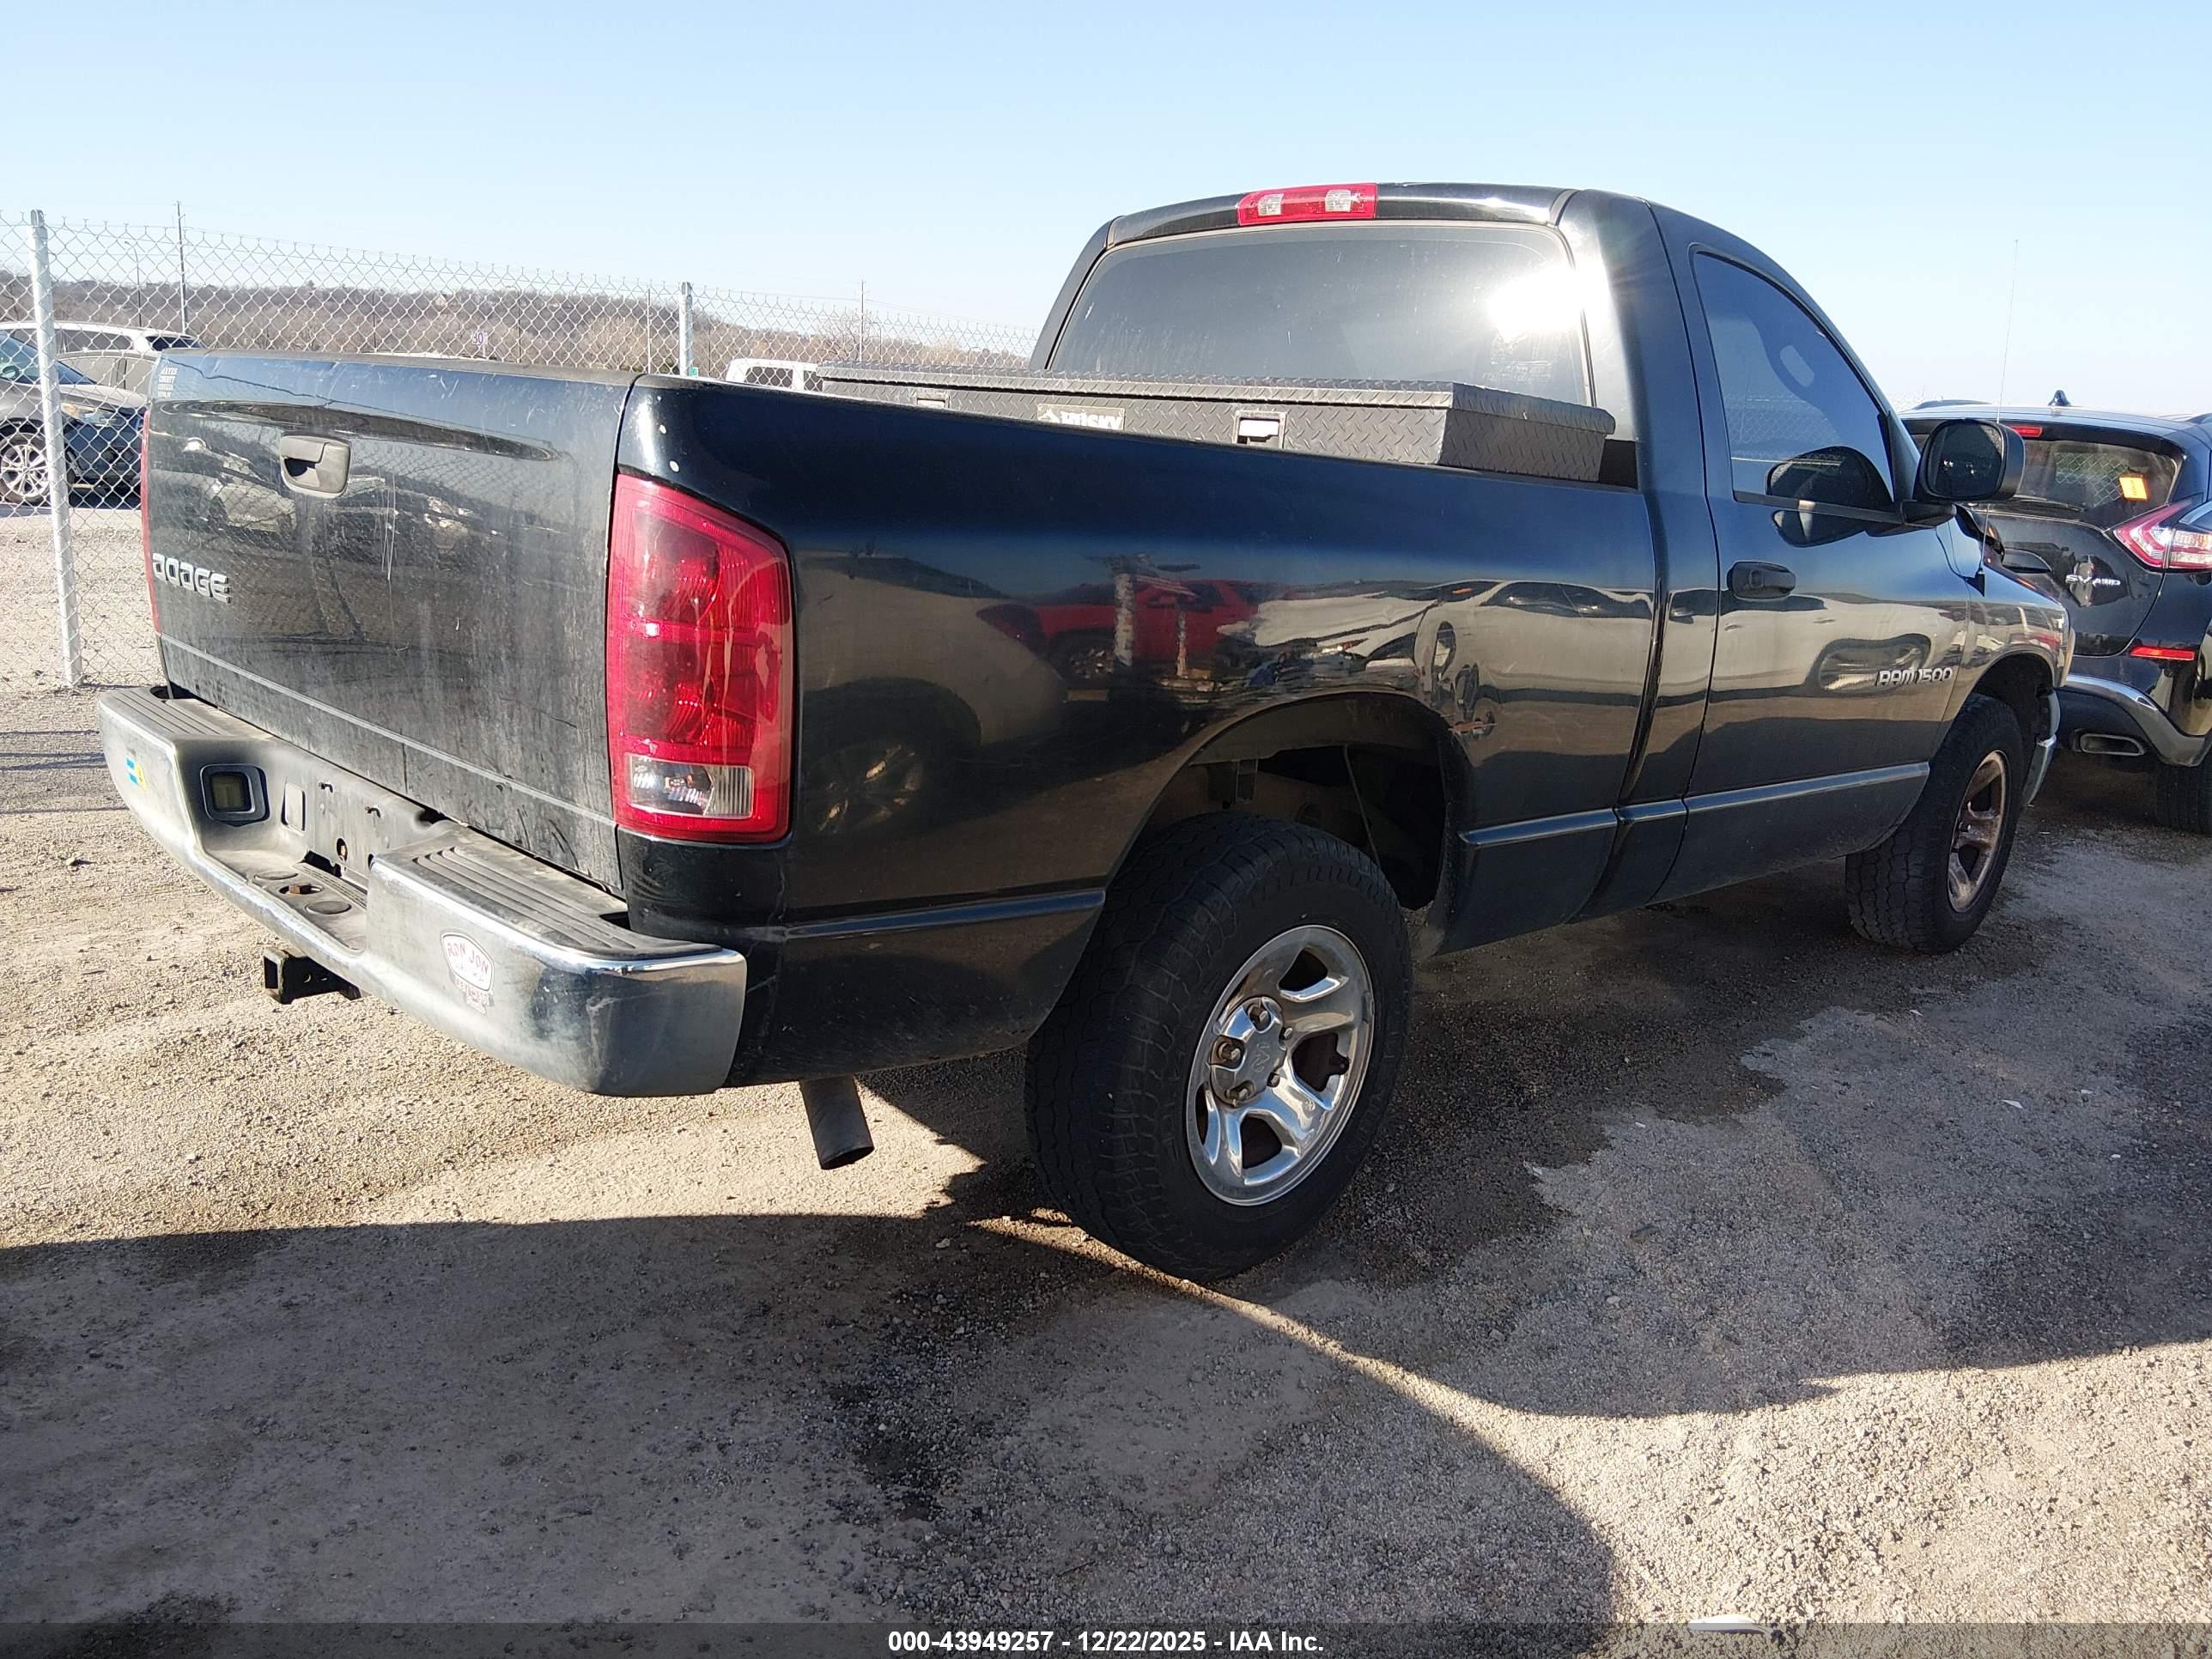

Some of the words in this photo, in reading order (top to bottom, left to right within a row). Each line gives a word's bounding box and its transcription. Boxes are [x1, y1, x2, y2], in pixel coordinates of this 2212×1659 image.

[152, 552, 232, 604] DODGE
[2065, 574, 2093, 585] SV
[1876, 670, 1916, 686] RAM
[1917, 667, 1954, 684] 1500
[447, 942, 466, 958] RON
[467, 950, 489, 975] JON
